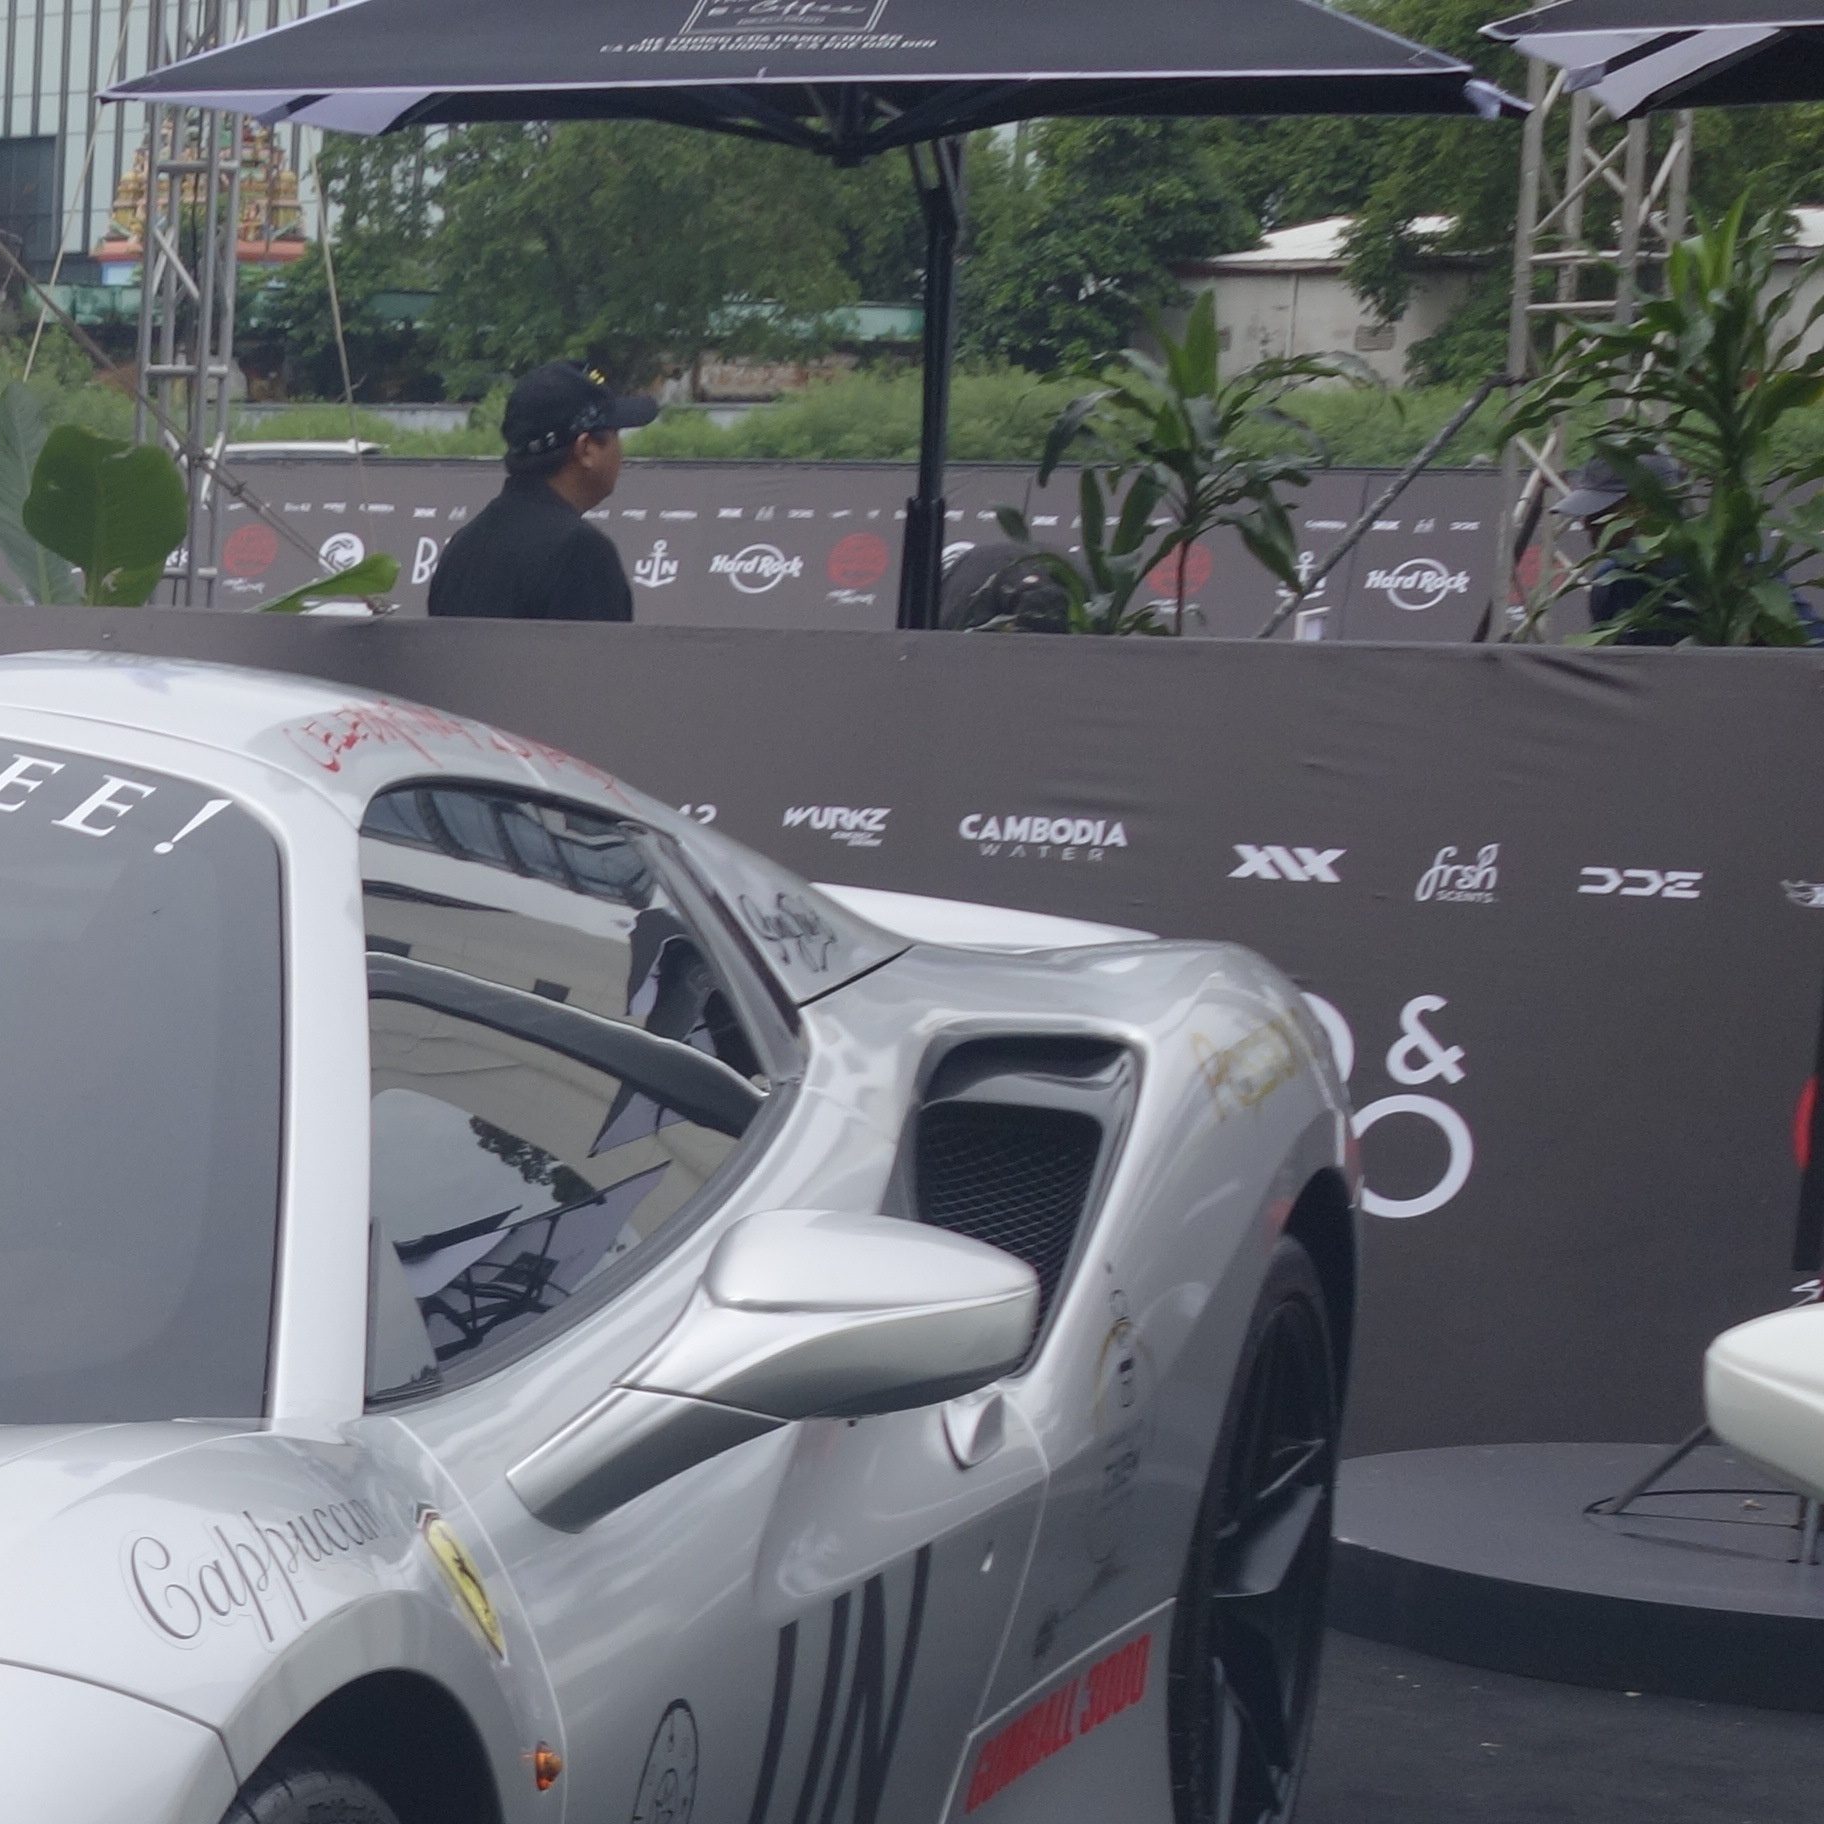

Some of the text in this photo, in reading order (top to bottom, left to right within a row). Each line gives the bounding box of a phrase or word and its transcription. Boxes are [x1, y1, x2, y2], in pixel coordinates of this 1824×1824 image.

[708, 554, 804, 578] Hard Rock
[1364, 569, 1471, 593] Hard Rock
[782, 805, 892, 832] WURKZ
[958, 812, 1129, 848] CAMBODIA
[978, 843, 1105, 863] WATER
